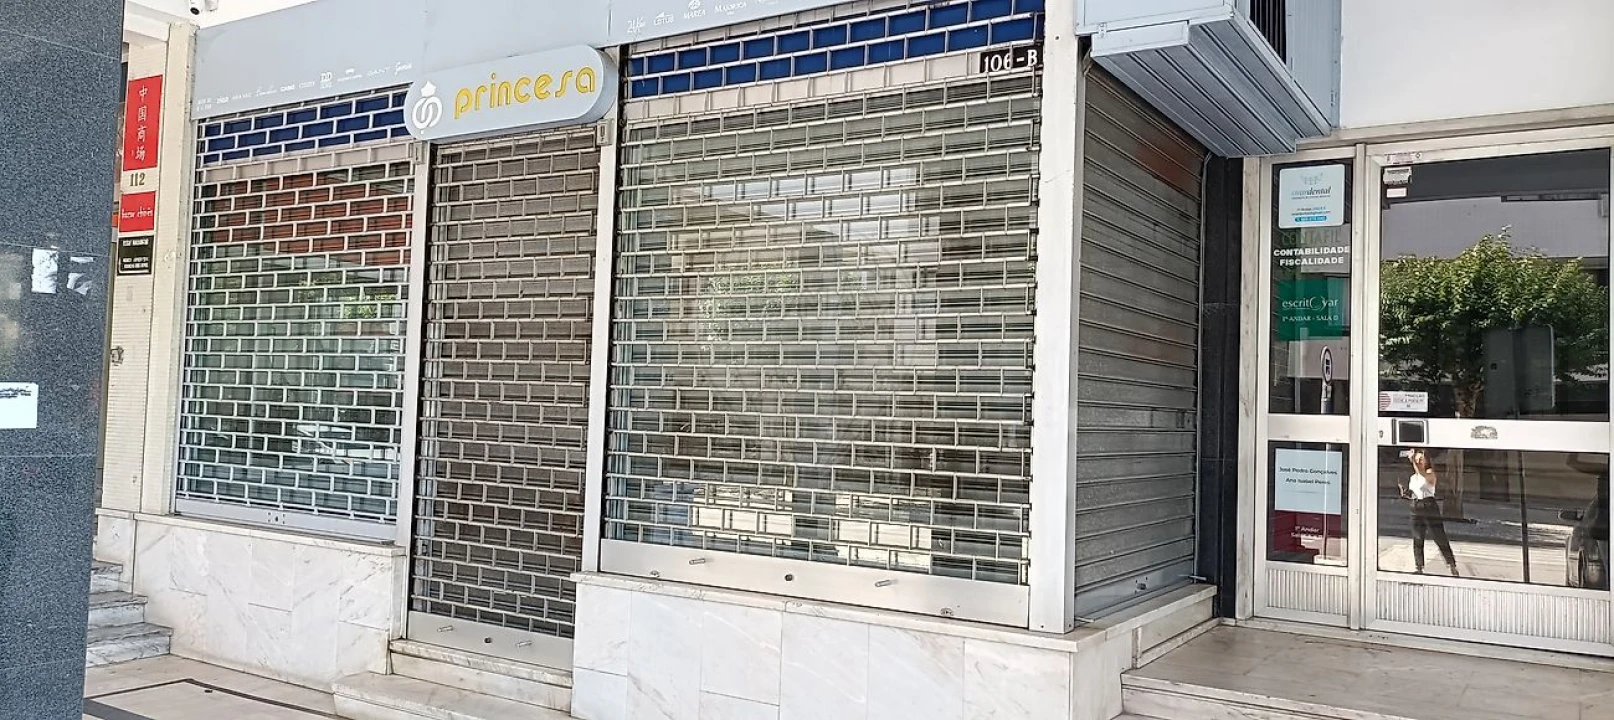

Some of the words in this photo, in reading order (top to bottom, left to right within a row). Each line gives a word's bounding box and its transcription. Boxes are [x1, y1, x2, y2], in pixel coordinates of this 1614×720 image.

[984, 49, 1037, 73] 106-B
[454, 66, 596, 120] princesa
[135, 84, 149, 162] 中国商场
[130, 173, 146, 187] 112
[1273, 245, 1350, 257] CONTABILIDADE
[1279, 256, 1344, 267] FISCALIDADE
